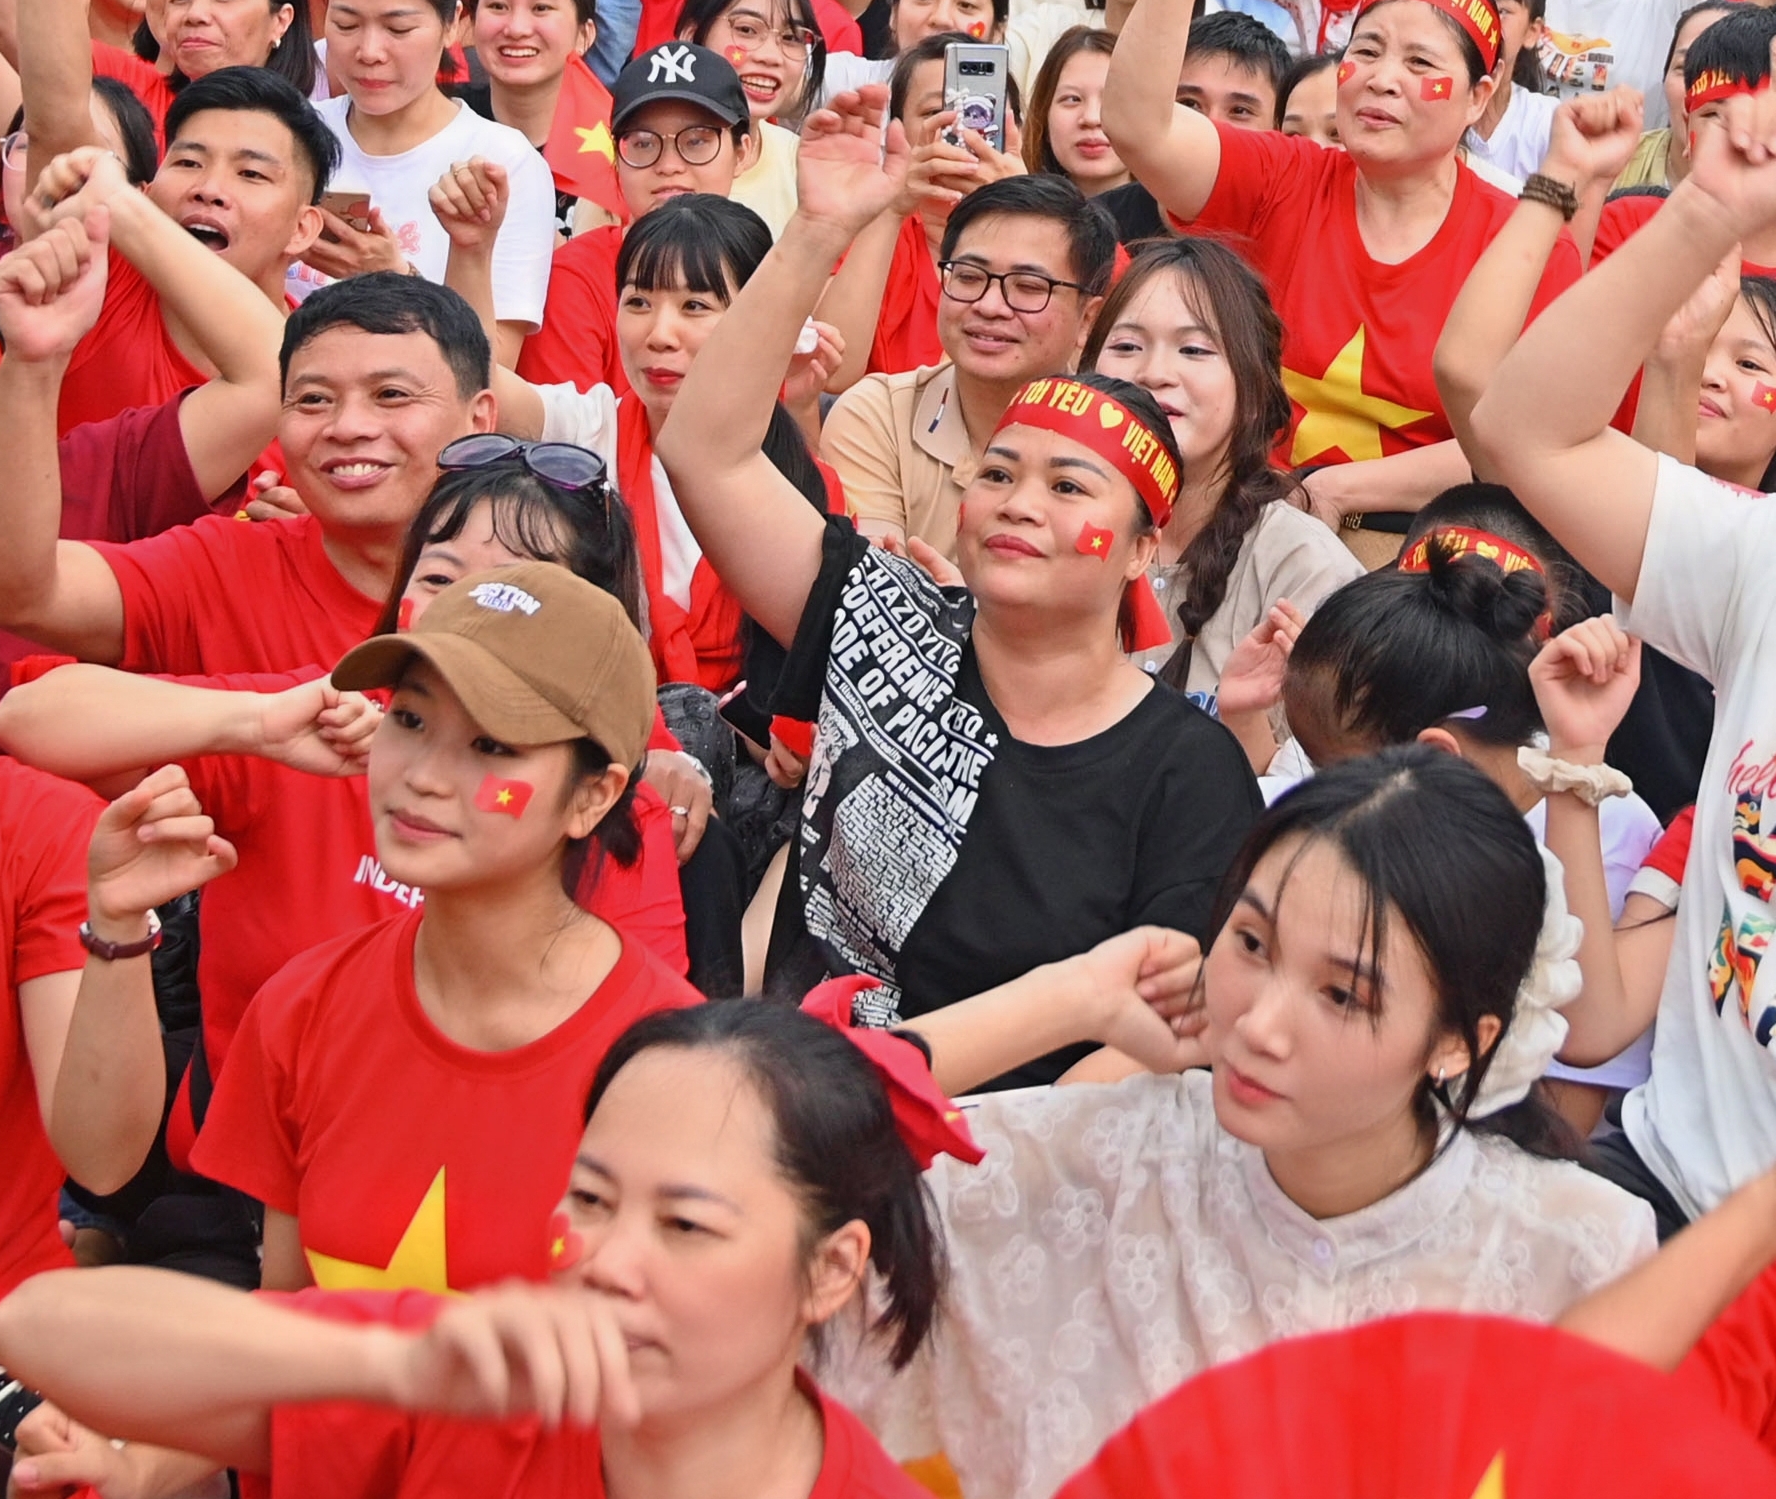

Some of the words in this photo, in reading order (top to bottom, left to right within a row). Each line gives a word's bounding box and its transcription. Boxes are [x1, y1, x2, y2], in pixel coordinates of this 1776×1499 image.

[647, 45, 698, 83] NY
[1048, 381, 1095, 417] YÊU
[1122, 419, 1158, 468] VIỆT
[1149, 449, 1177, 498] NAM
[856, 668, 902, 714] OF
